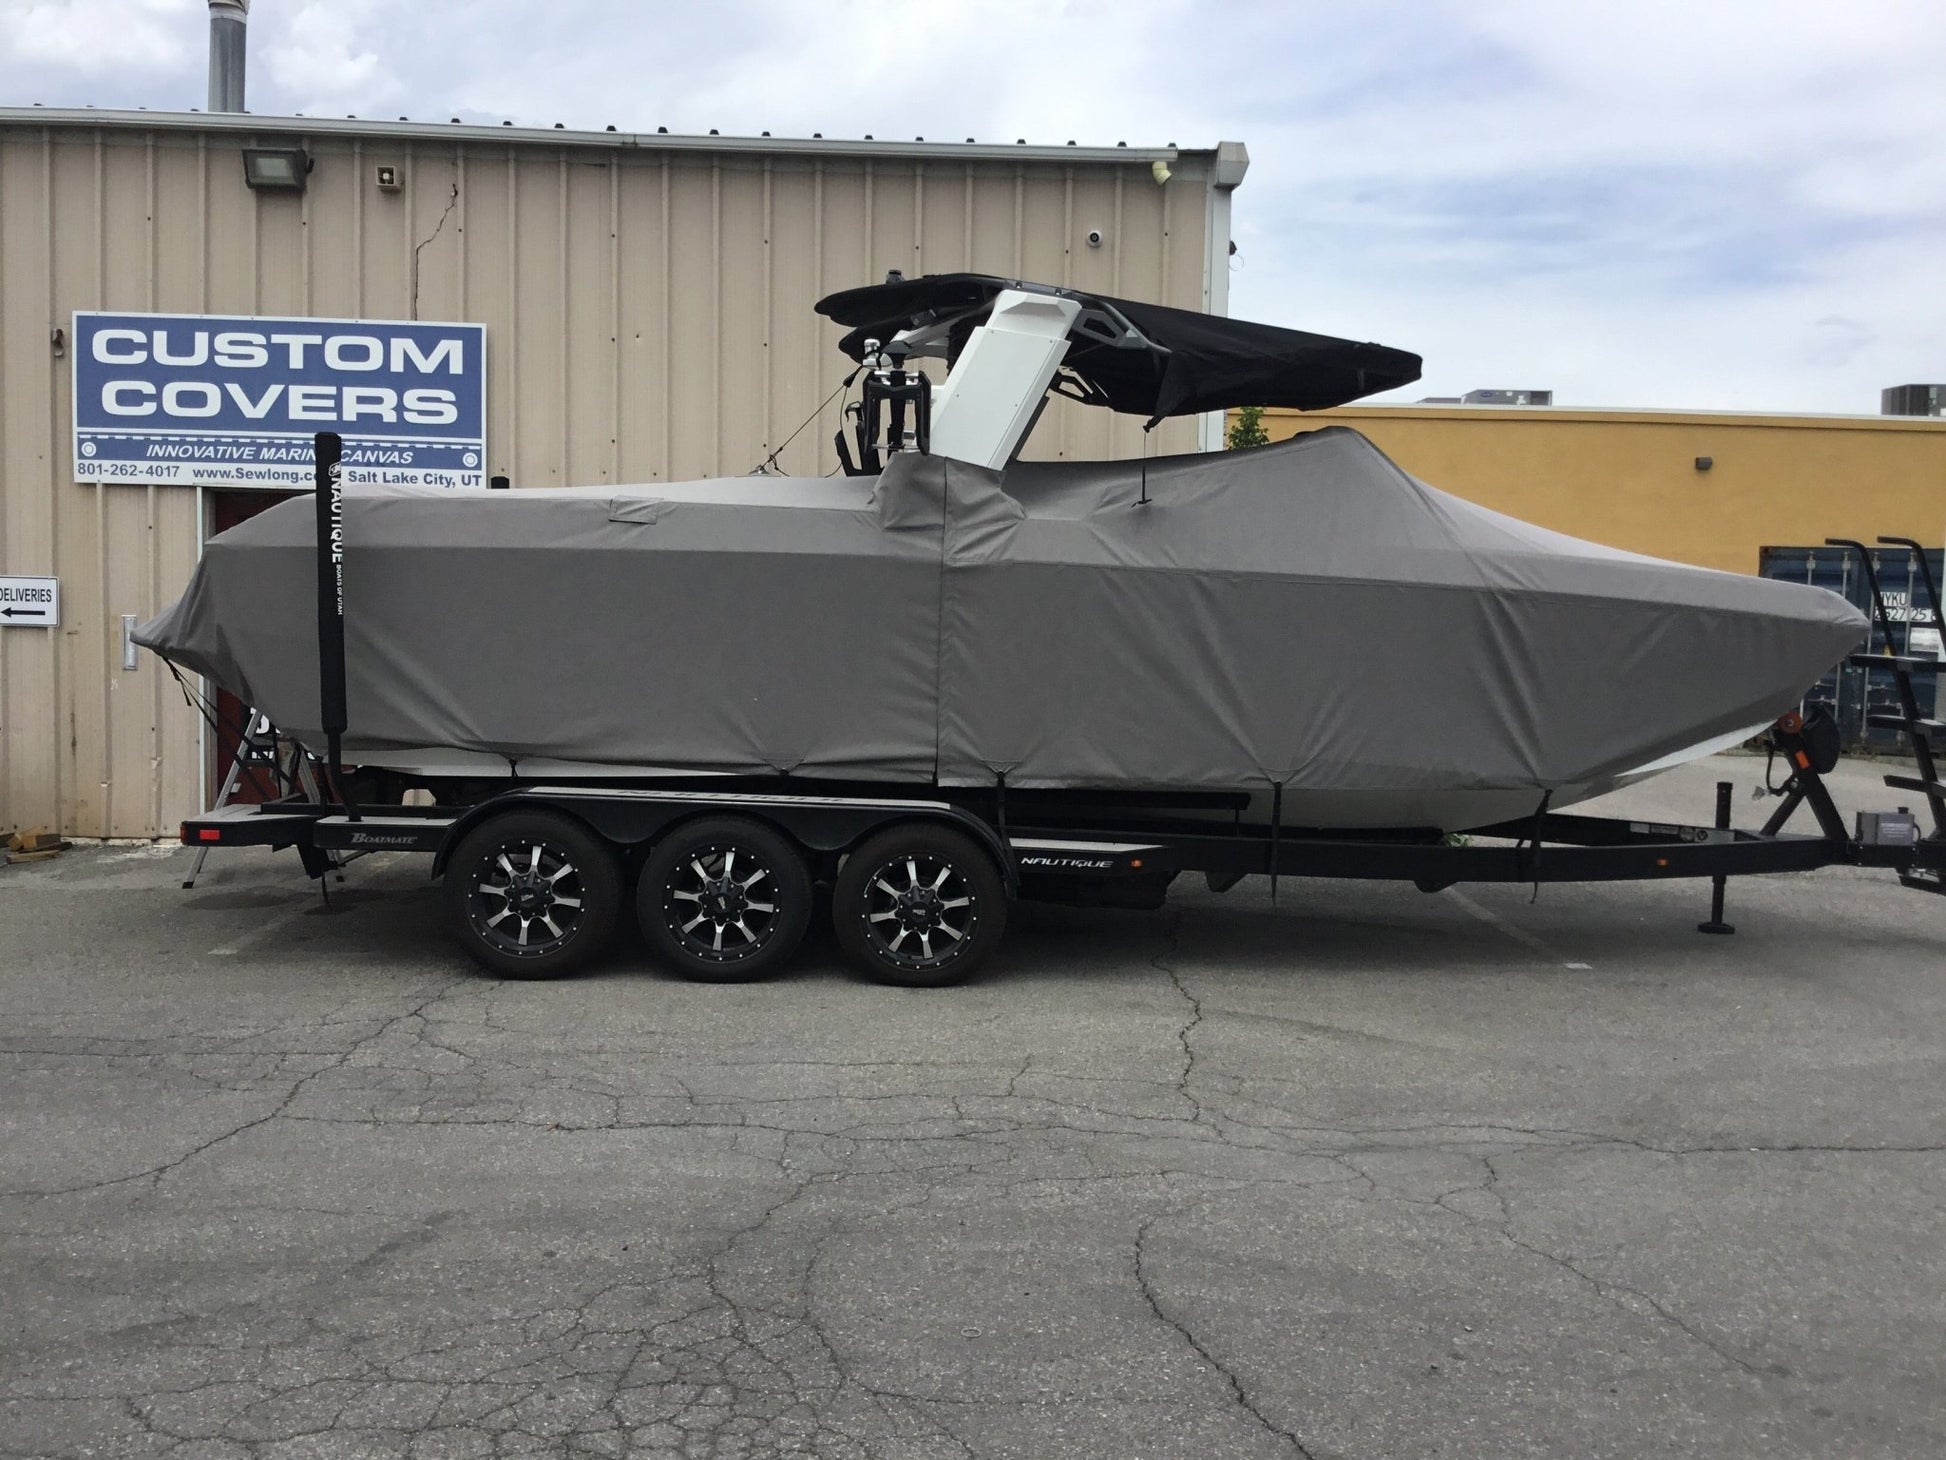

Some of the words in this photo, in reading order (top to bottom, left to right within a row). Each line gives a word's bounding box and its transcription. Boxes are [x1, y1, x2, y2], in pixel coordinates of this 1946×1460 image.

[92, 329, 463, 375] CUSTOM
[101, 380, 458, 425] COVERS
[146, 444, 256, 460] INNOVATIVE
[259, 447, 317, 462] MARIN
[341, 450, 413, 464] CANVAS
[77, 463, 180, 478] 801-262-4017
[348, 471, 377, 483] Salt
[383, 472, 418, 484] Lake
[423, 473, 456, 488] City,
[461, 474, 482, 486] UT
[330, 477, 343, 563] NAUTIQUE
[1021, 857, 1114, 868] NAUTIQUE
